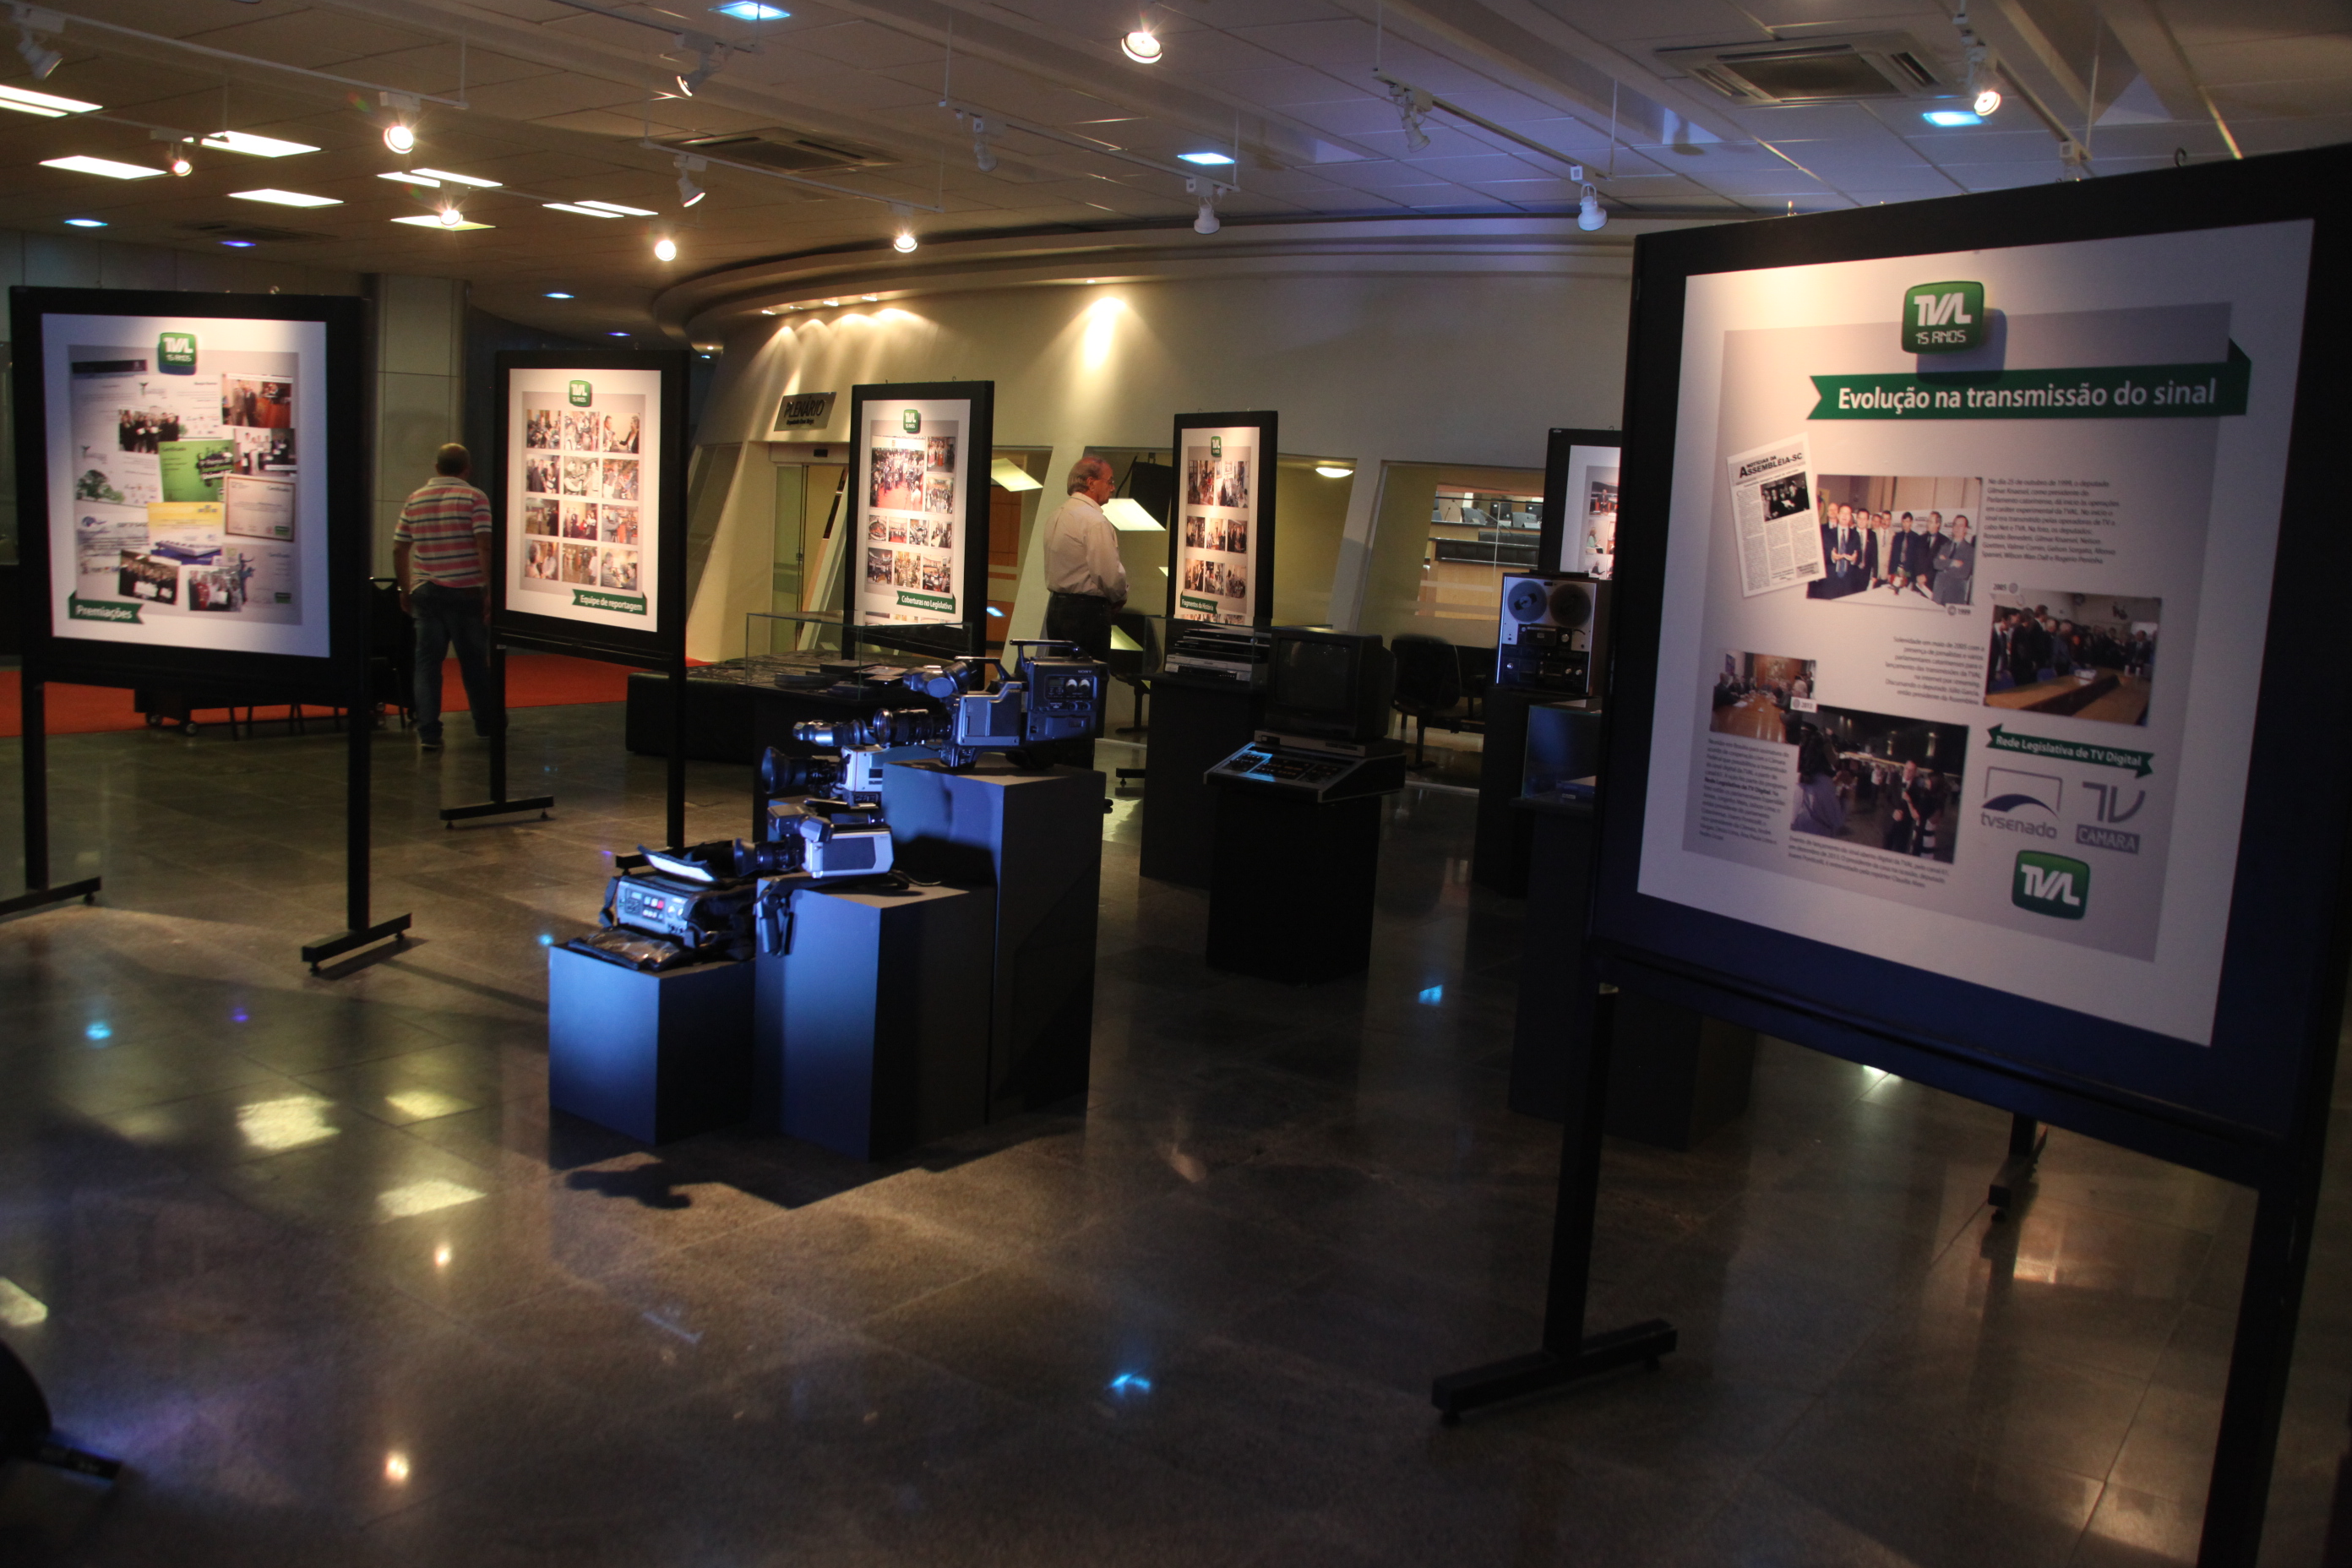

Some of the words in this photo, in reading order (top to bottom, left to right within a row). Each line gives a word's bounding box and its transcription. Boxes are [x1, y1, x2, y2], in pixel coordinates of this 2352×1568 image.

[1916, 331, 1929, 345] 15
[1931, 329, 1966, 344] ANOS
[784, 395, 825, 417] PLENÁRIO
[1838, 386, 1930, 415] Evolução
[1936, 389, 1960, 409] na
[1967, 383, 2107, 410] transmissão
[2114, 381, 2147, 406] do
[2154, 378, 2215, 406] sinal
[76, 605, 133, 620] Premiações
[580, 595, 600, 607] Equipe
[600, 598, 608, 606] de
[608, 601, 643, 612] reportagem
[901, 595, 924, 606] Coberturas
[930, 600, 953, 610] Legislativo
[1995, 735, 2020, 748] Rede
[2022, 739, 2074, 756] Legislativa
[2076, 746, 2089, 758] de
[2090, 749, 2104, 760] TV
[2106, 751, 2141, 766] Digital
[2082, 781, 2146, 823] TV
[1980, 812, 2057, 839] tvsenado
